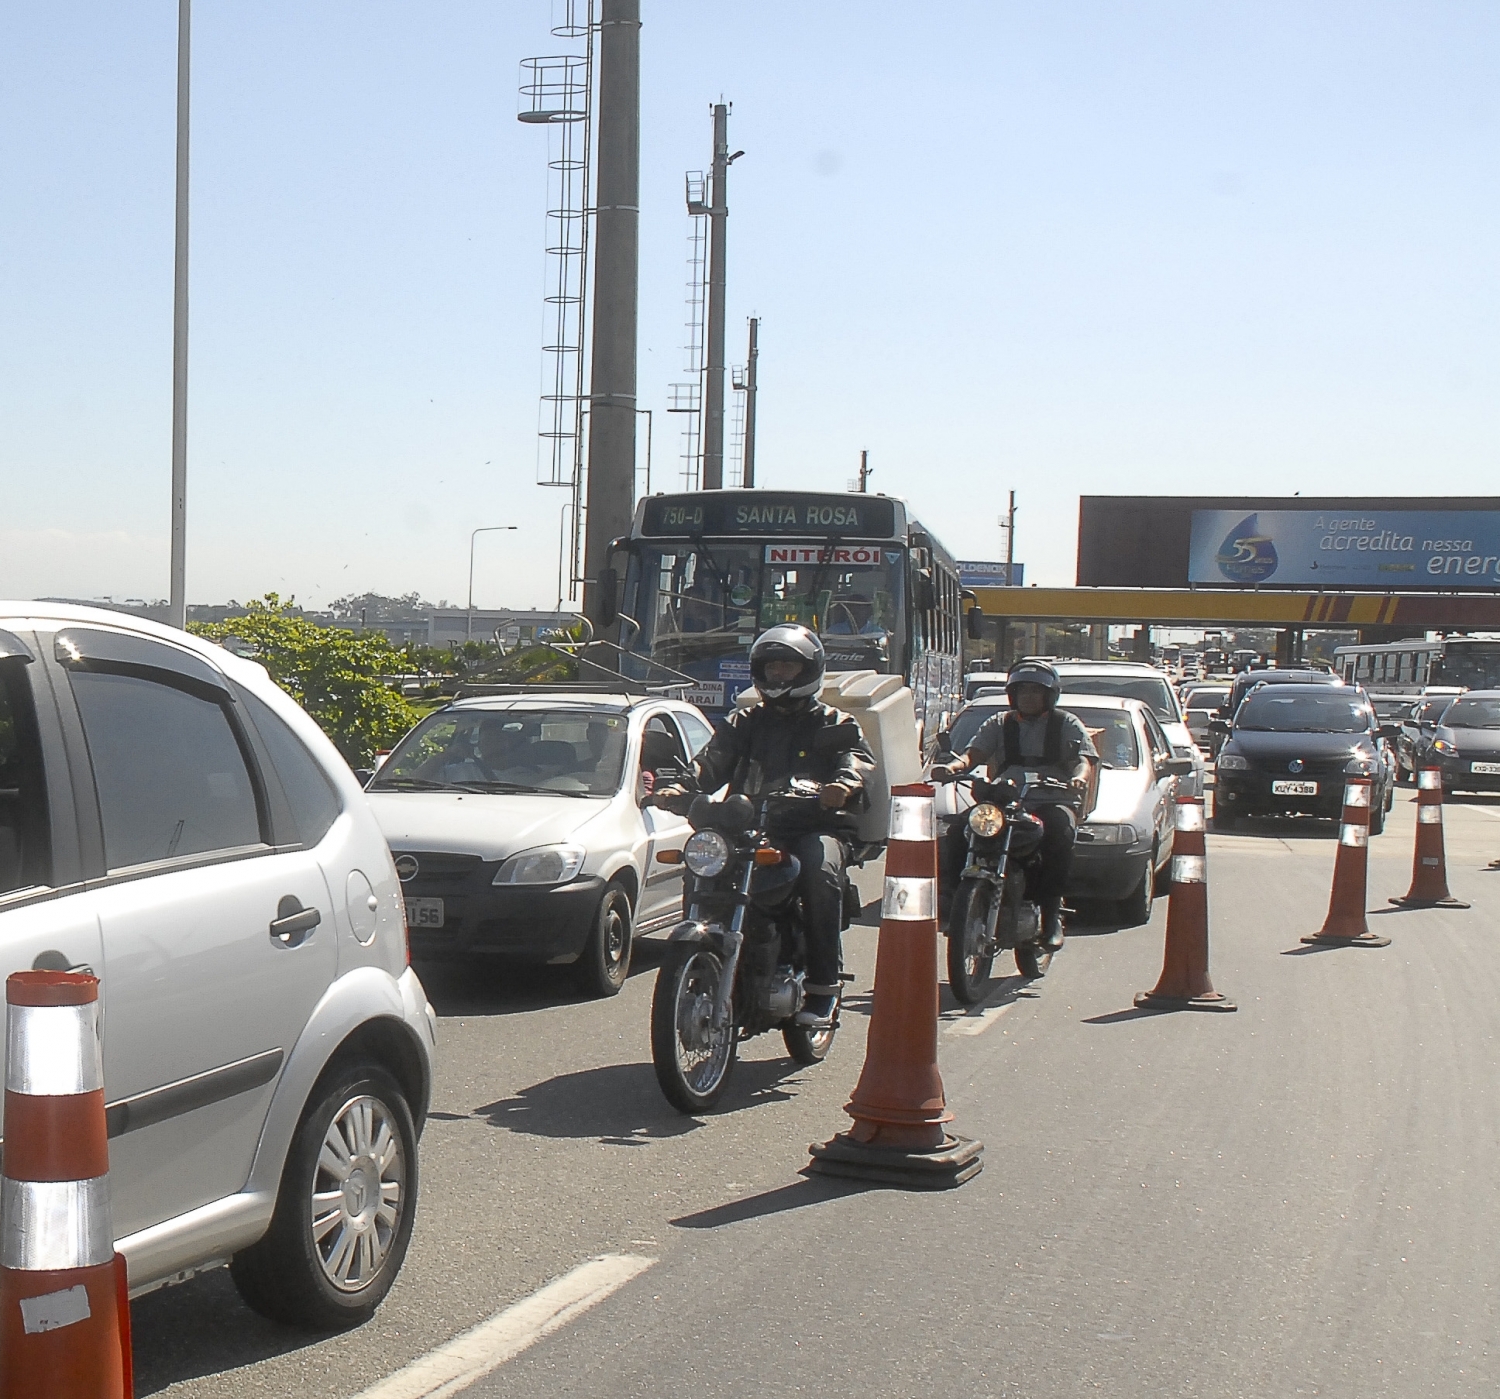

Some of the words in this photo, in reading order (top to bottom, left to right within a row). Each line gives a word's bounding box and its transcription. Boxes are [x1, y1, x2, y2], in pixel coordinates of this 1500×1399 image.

[663, 506, 703, 524] 750-D
[736, 505, 797, 524] SANTA
[806, 506, 859, 526] ROSA
[1313, 516, 1326, 530] A
[1328, 517, 1376, 534] gente
[1319, 530, 1414, 551] acredita
[1421, 540, 1473, 552] nessa
[770, 547, 880, 563] NITERÓI
